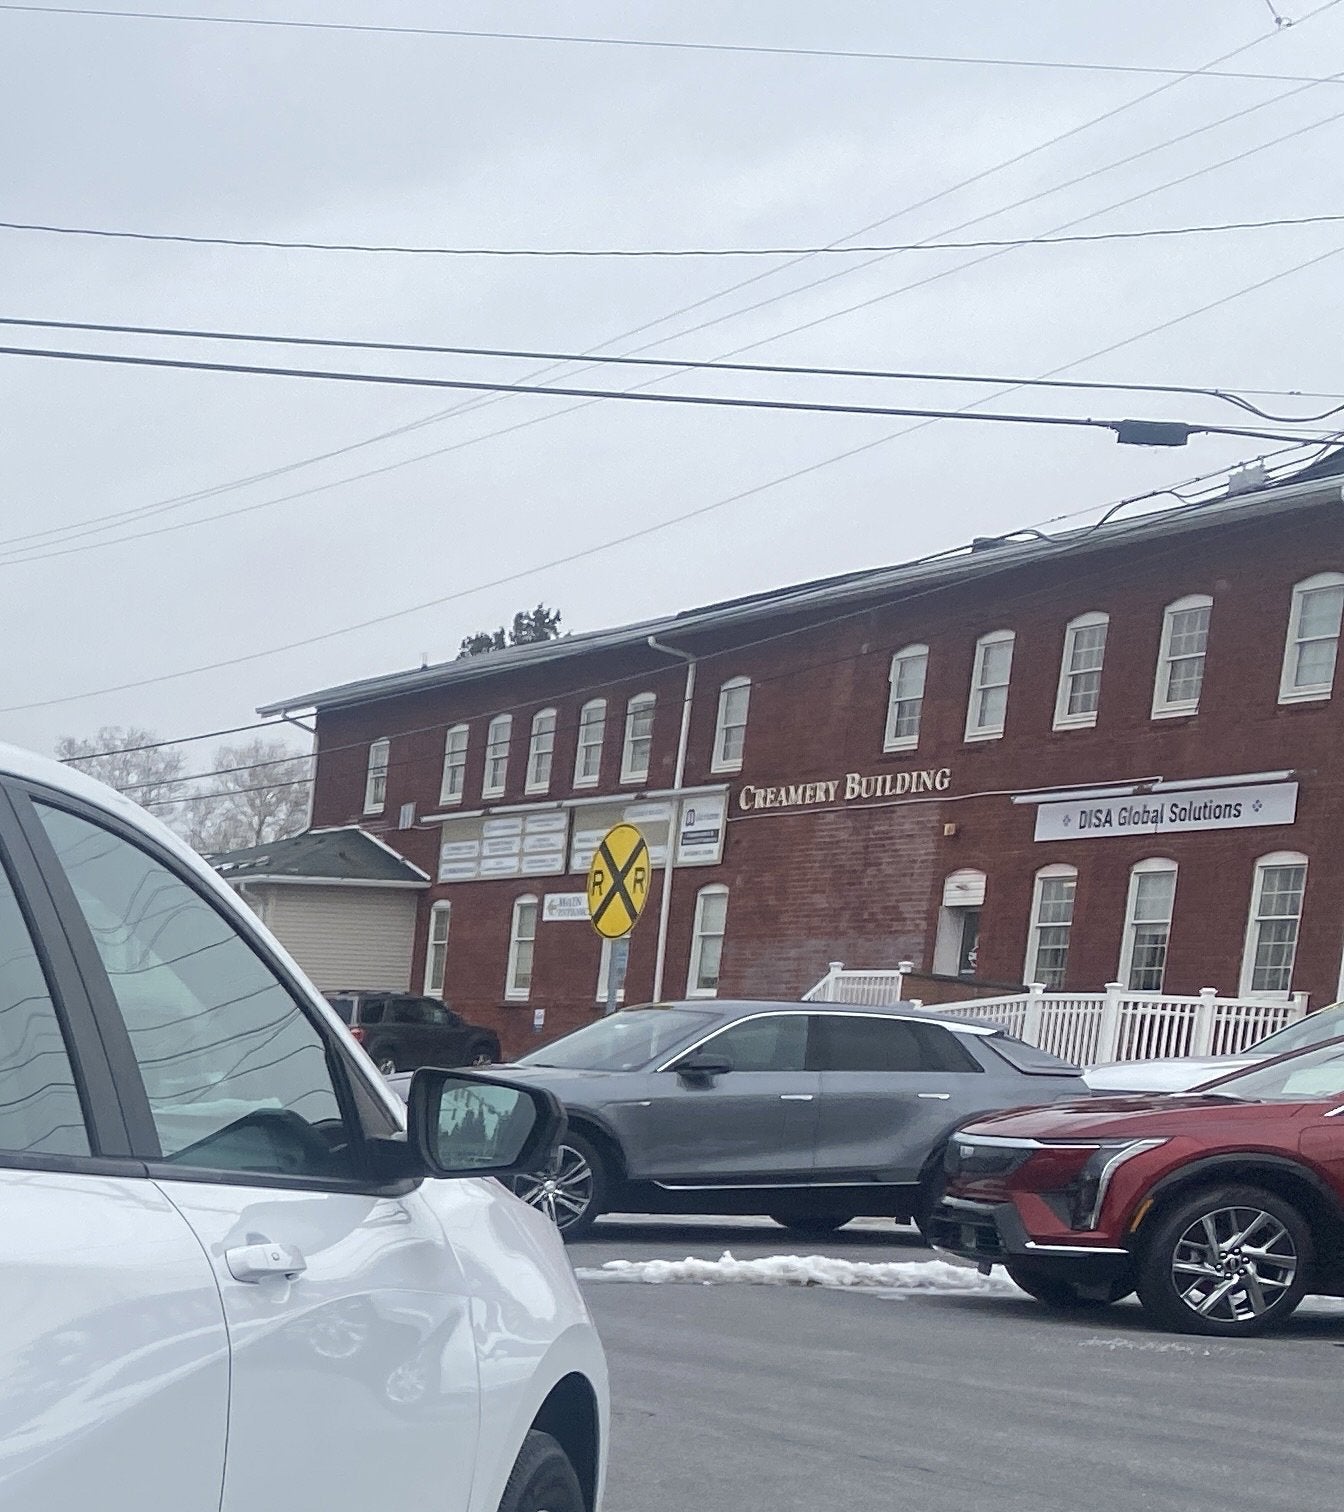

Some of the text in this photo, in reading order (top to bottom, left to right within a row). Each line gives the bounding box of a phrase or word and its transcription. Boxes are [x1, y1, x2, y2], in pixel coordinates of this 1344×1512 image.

[739, 768, 952, 810] CREAMERY BUILDING
[1078, 800, 1243, 830] DISA Global Solutions
